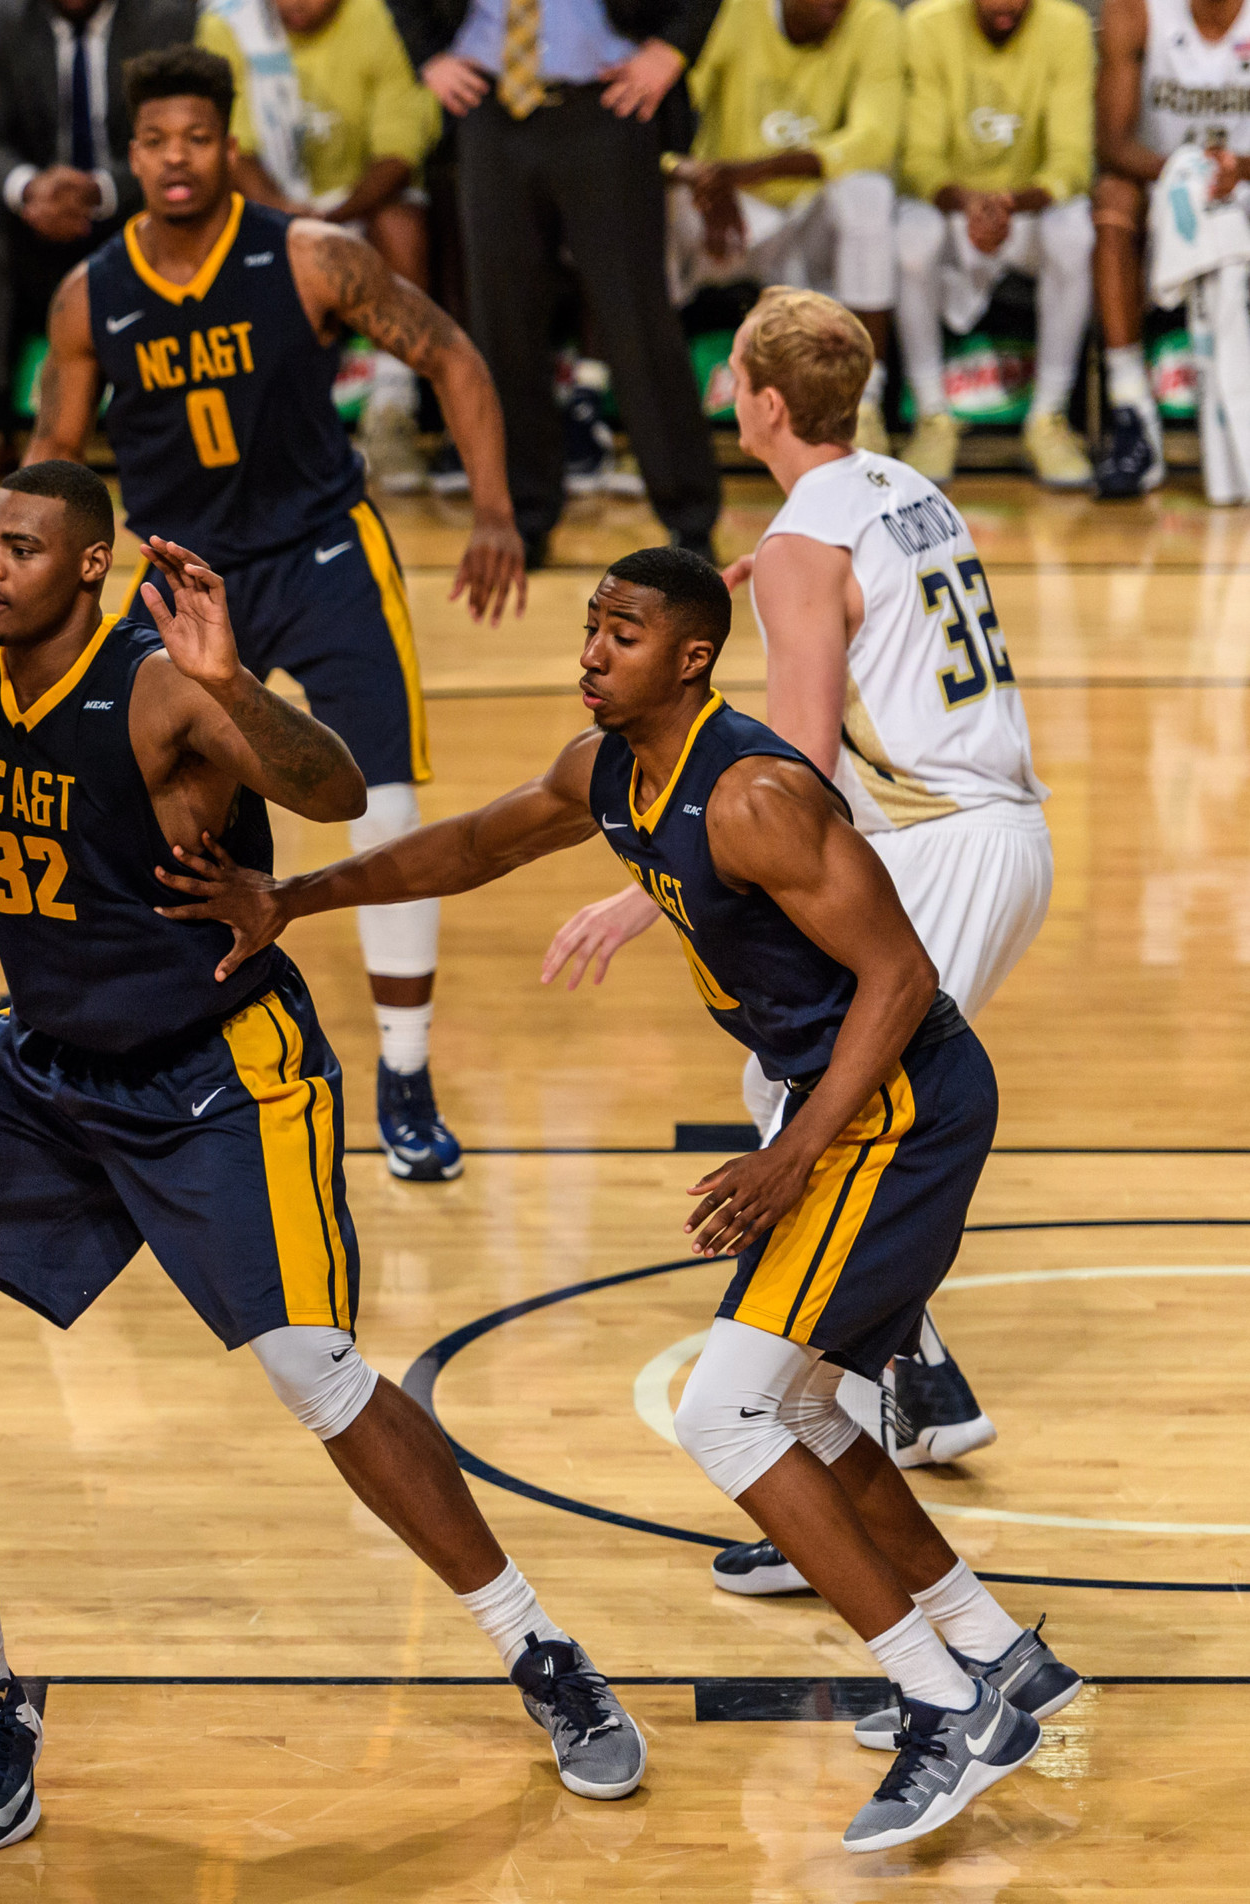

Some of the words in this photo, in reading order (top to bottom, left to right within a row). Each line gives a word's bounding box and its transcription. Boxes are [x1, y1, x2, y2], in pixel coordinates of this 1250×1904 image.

[135, 336, 187, 392] NC
[190, 320, 255, 383] A&T
[186, 388, 240, 469] 0
[917, 553, 1017, 713] 32
[83, 701, 114, 710] MEAC
[12, 766, 76, 832] A&T
